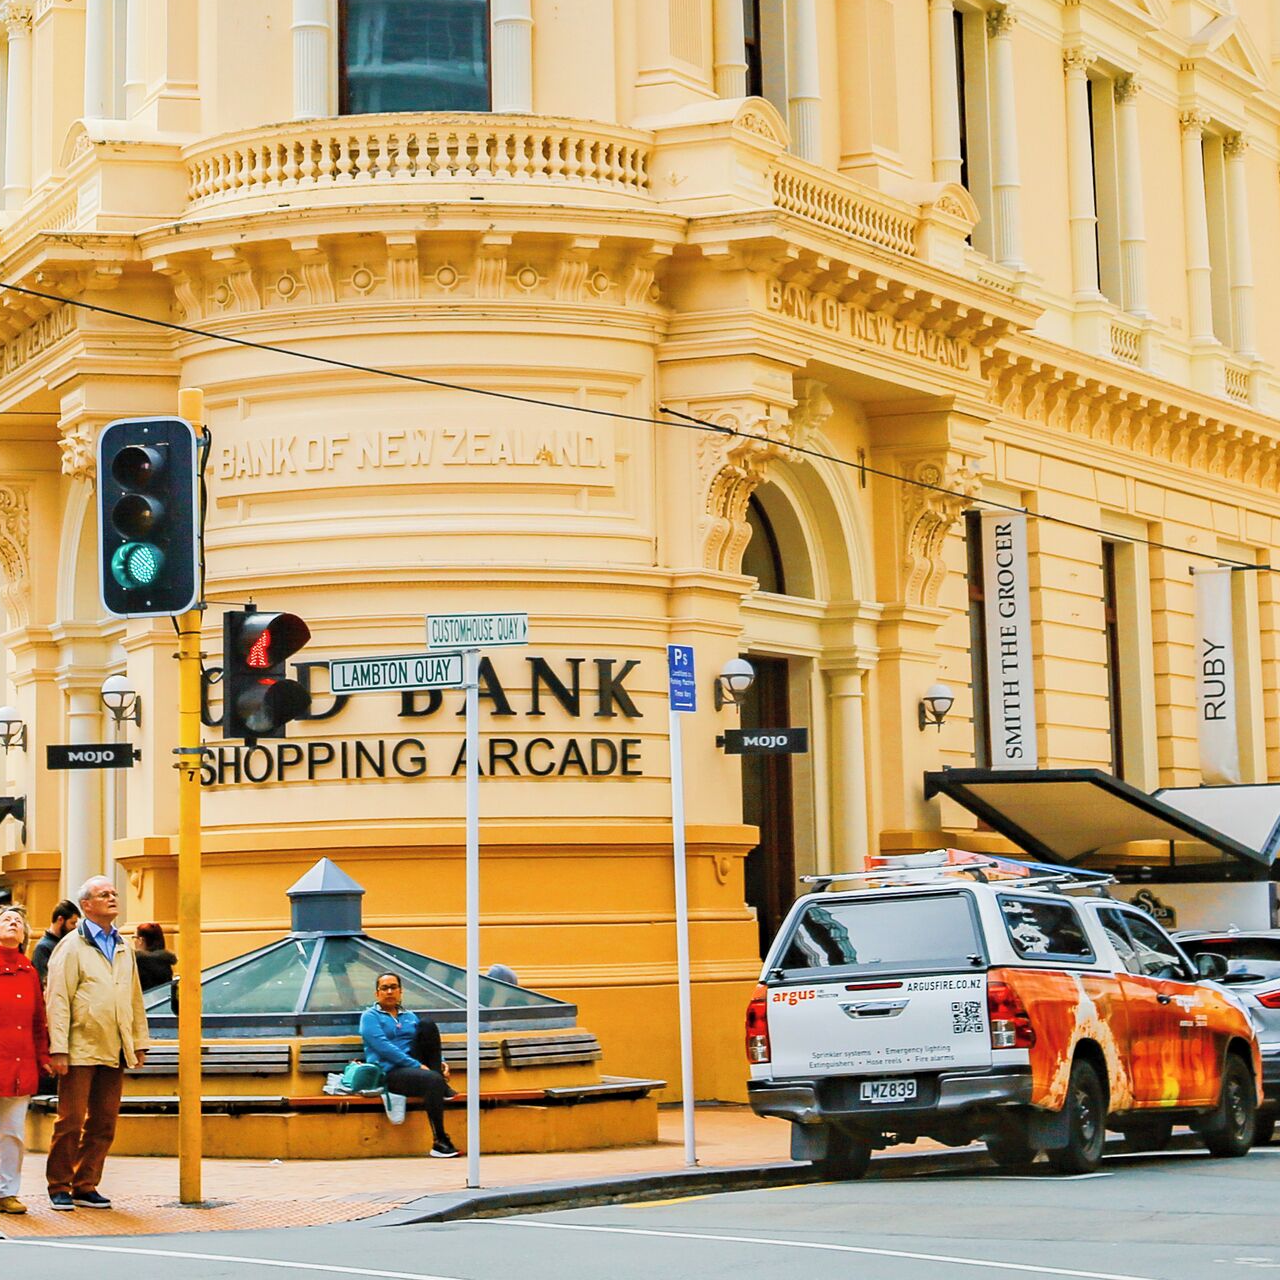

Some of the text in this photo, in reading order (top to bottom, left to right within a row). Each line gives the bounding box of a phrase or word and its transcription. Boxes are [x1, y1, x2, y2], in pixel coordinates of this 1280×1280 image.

[219, 437, 298, 481] BANK
[303, 432, 349, 471] OF
[356, 429, 437, 469] NEW
[432, 618, 520, 643] CUSTOMHOUSE QUAY
[995, 521, 1024, 759] SMITH THE GROCER
[341, 659, 451, 688] LAMBTON QUAY
[1202, 638, 1228, 722] RUBY
[742, 735, 788, 748] MOJO
[67, 750, 115, 763] MOJO
[200, 737, 644, 787] SHOPPING ARCADE
[187, 771, 195, 782] 7
[907, 979, 981, 992] ARGUSFIRE.CO.NZ
[772, 989, 816, 1006] argus
[811, 1044, 952, 1060] Sprinkler systems Emergency lighting
[808, 1059, 855, 1070] Extinguishers
[915, 1055, 929, 1063] Fire
[930, 1053, 955, 1063] alarms
[862, 1081, 915, 1099] LMZ839
